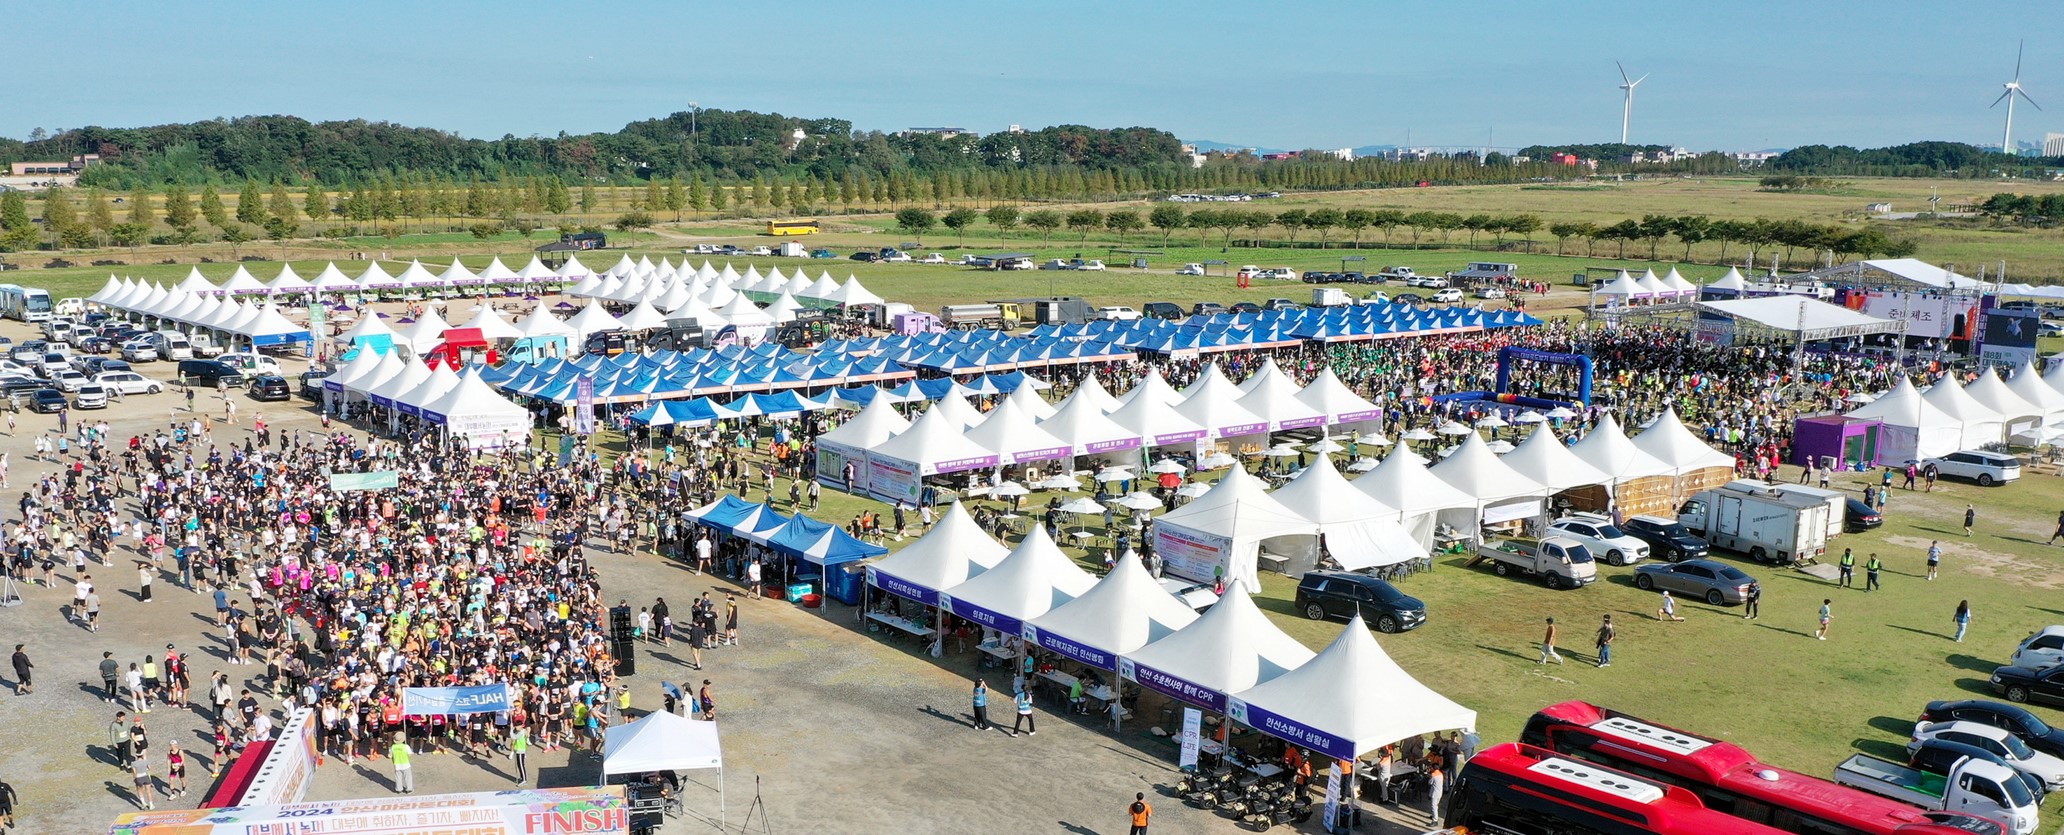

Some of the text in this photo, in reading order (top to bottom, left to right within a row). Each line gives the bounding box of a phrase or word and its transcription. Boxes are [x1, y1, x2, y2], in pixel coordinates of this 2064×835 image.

[1910, 310, 1932, 321] 체조
[1983, 350, 2002, 359] 제8회
[972, 609, 995, 625] 의료지원
[1045, 636, 1104, 665] 근로복지공단 안산병원
[1140, 668, 1153, 680] 안산
[1152, 673, 1183, 691] 수호천사와
[1183, 684, 1198, 697] 함께
[1197, 690, 1214, 702] CPR
[1183, 730, 1198, 739] CPR
[1265, 717, 1330, 749] 안산소방서 상황실
[1182, 742, 1197, 750] LIFE
[276, 808, 334, 818] 2024
[380, 799, 477, 811] 마라톤대회
[332, 816, 368, 830] 대부에
[372, 814, 412, 828] 취하자,
[417, 811, 456, 825] 즐기자,
[459, 809, 499, 823] 빠지자!
[525, 808, 625, 834] FINISH
